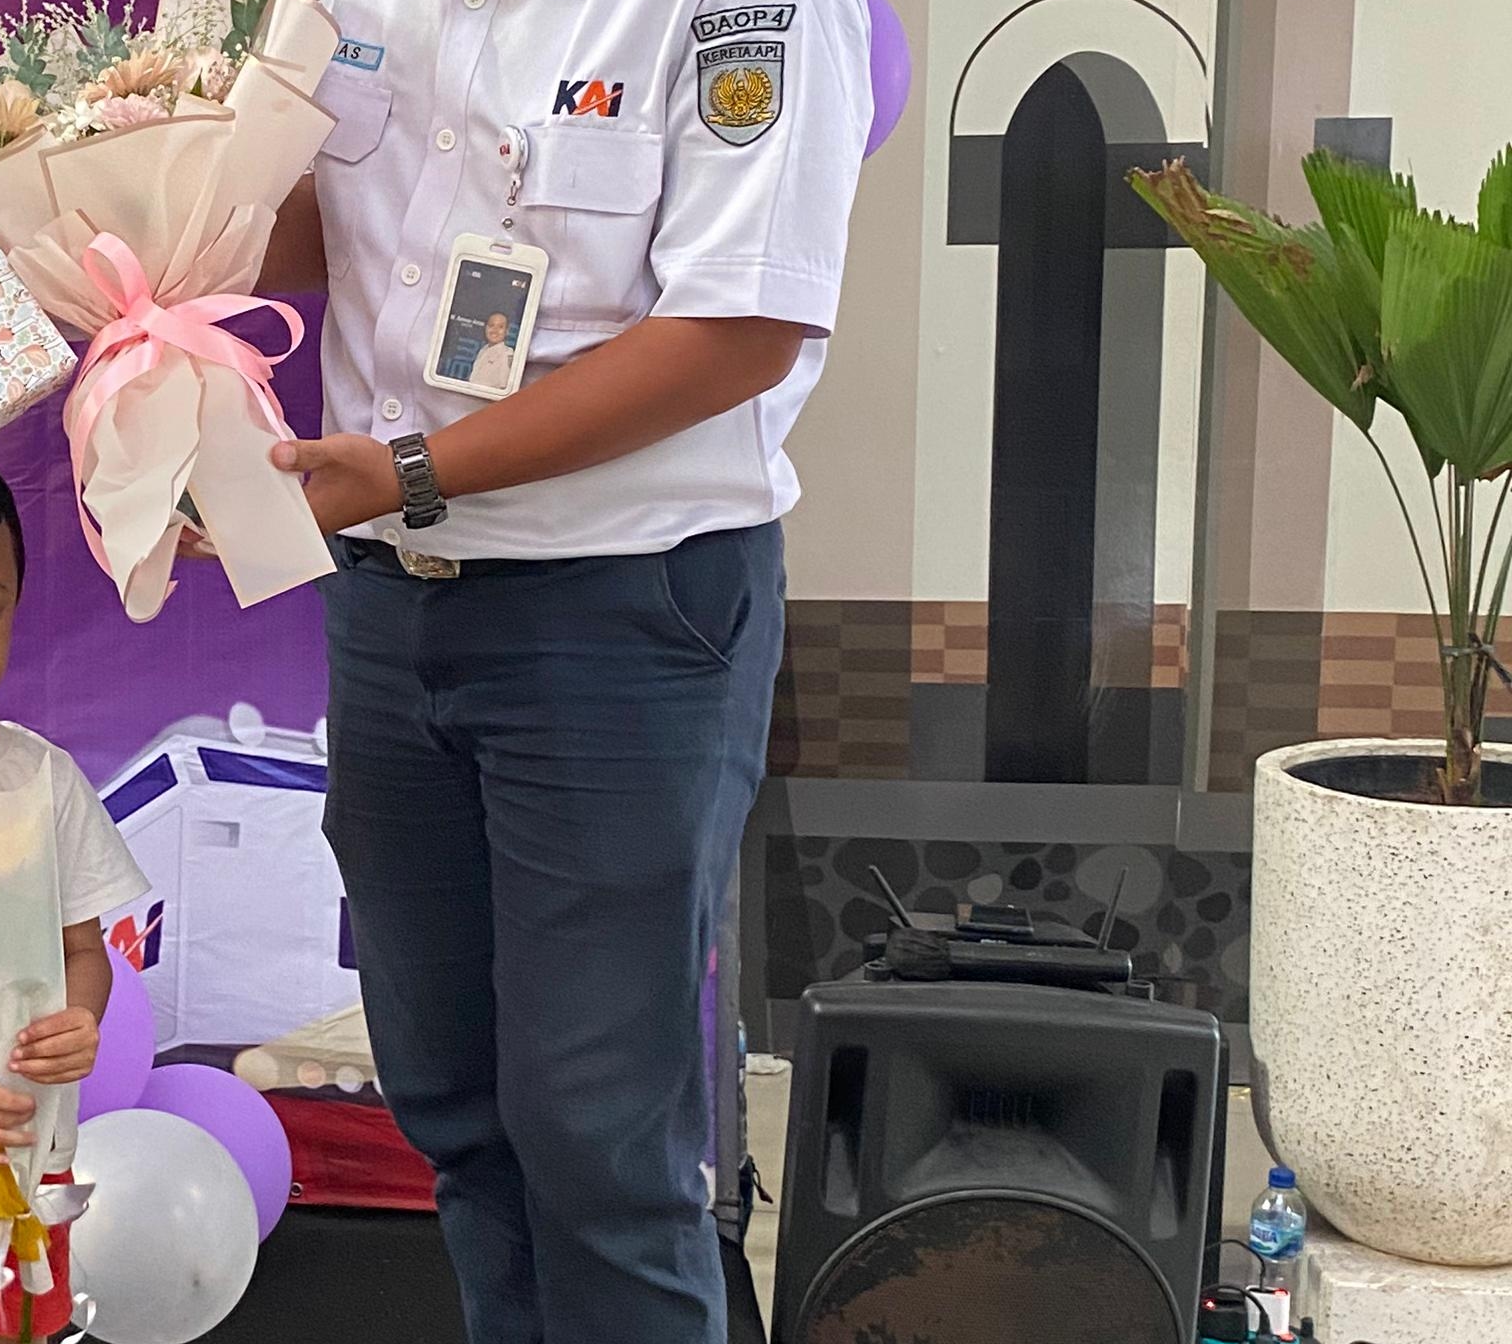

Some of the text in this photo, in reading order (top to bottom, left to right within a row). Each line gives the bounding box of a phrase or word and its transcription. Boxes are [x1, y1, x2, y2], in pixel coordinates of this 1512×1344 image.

[699, 8, 786, 37] DAOP 4
[702, 46, 752, 65] KERETA
[551, 79, 625, 118] KAI
[100, 899, 166, 973] AI
